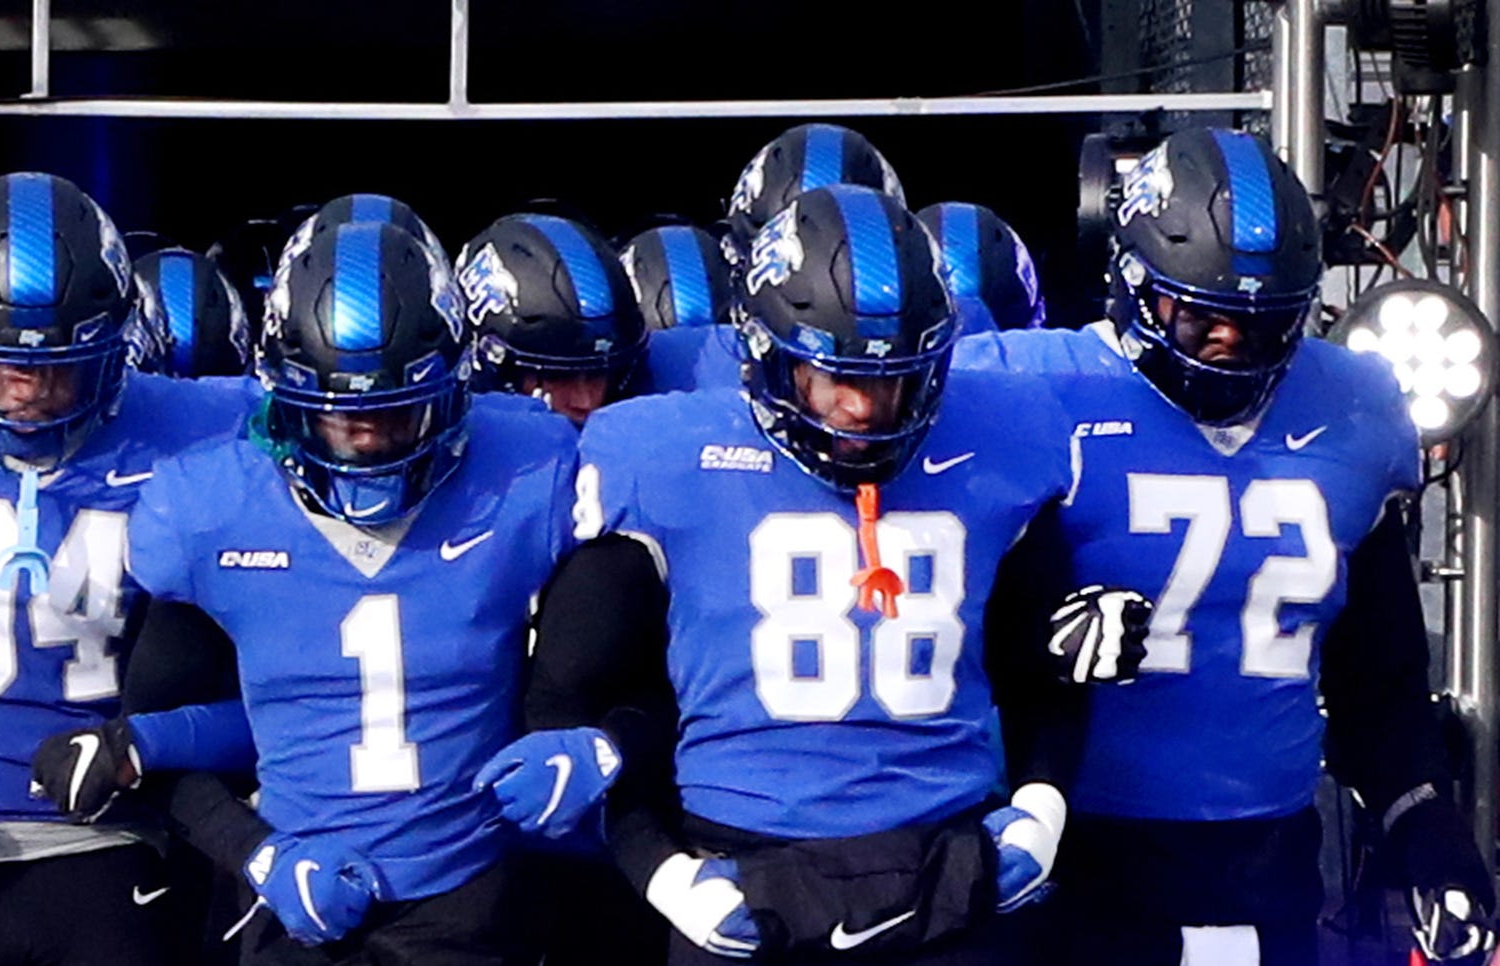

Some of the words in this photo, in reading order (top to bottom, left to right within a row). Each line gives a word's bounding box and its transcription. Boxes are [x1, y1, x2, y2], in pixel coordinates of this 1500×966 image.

[748, 510, 968, 723] 88
[1126, 472, 1338, 680] 72
[339, 593, 422, 792] 1
